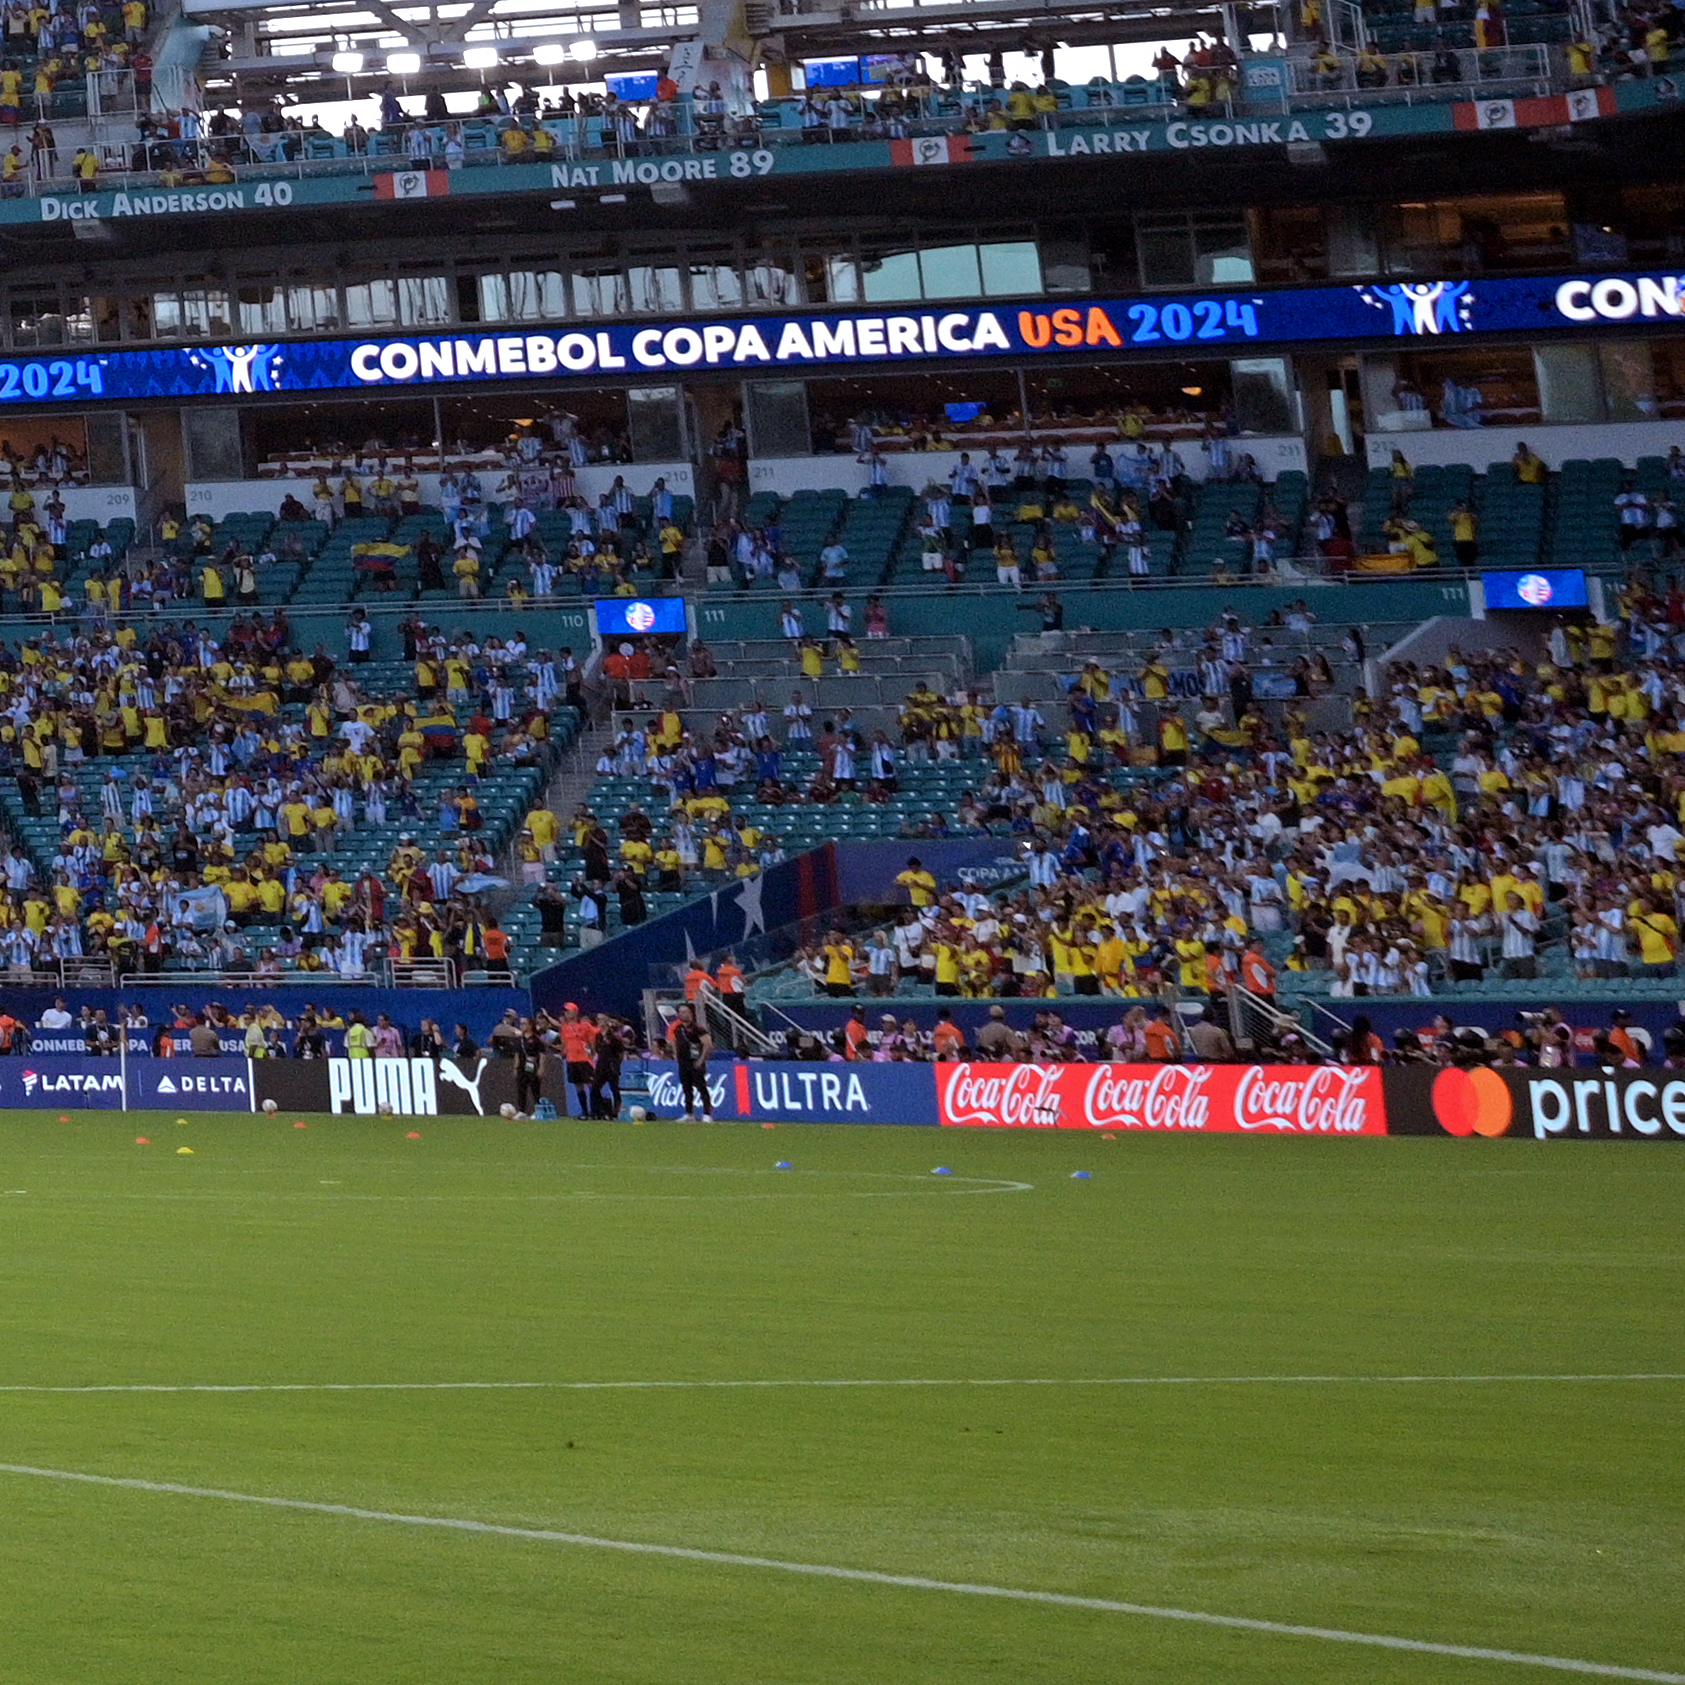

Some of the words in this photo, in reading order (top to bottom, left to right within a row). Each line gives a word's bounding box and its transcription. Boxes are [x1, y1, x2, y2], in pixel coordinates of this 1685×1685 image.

[1048, 128, 1151, 158] LARRY
[1166, 118, 1310, 150] CSONKA
[1324, 112, 1372, 140] 39
[552, 163, 604, 189] NAT
[613, 154, 716, 184] MOORE
[730, 149, 774, 178] 89
[40, 195, 104, 222] DICK
[112, 187, 244, 217] ANDERSON
[254, 181, 293, 207] 40
[351, 332, 624, 382] CONMEBOL
[631, 322, 769, 366] COPA
[776, 312, 1010, 360] AMERICA
[1018, 306, 1121, 349] USA
[1128, 299, 1258, 343] 2024
[665, 470, 687, 482] 210
[107, 494, 129, 506] 209
[190, 490, 212, 502] 210
[563, 615, 583, 628] 110
[705, 610, 724, 622] 111
[42, 1075, 122, 1091] LATAM
[181, 1077, 246, 1092] DELTA
[329, 1058, 437, 1114] PUMA
[755, 1072, 870, 1111] ULTRA
